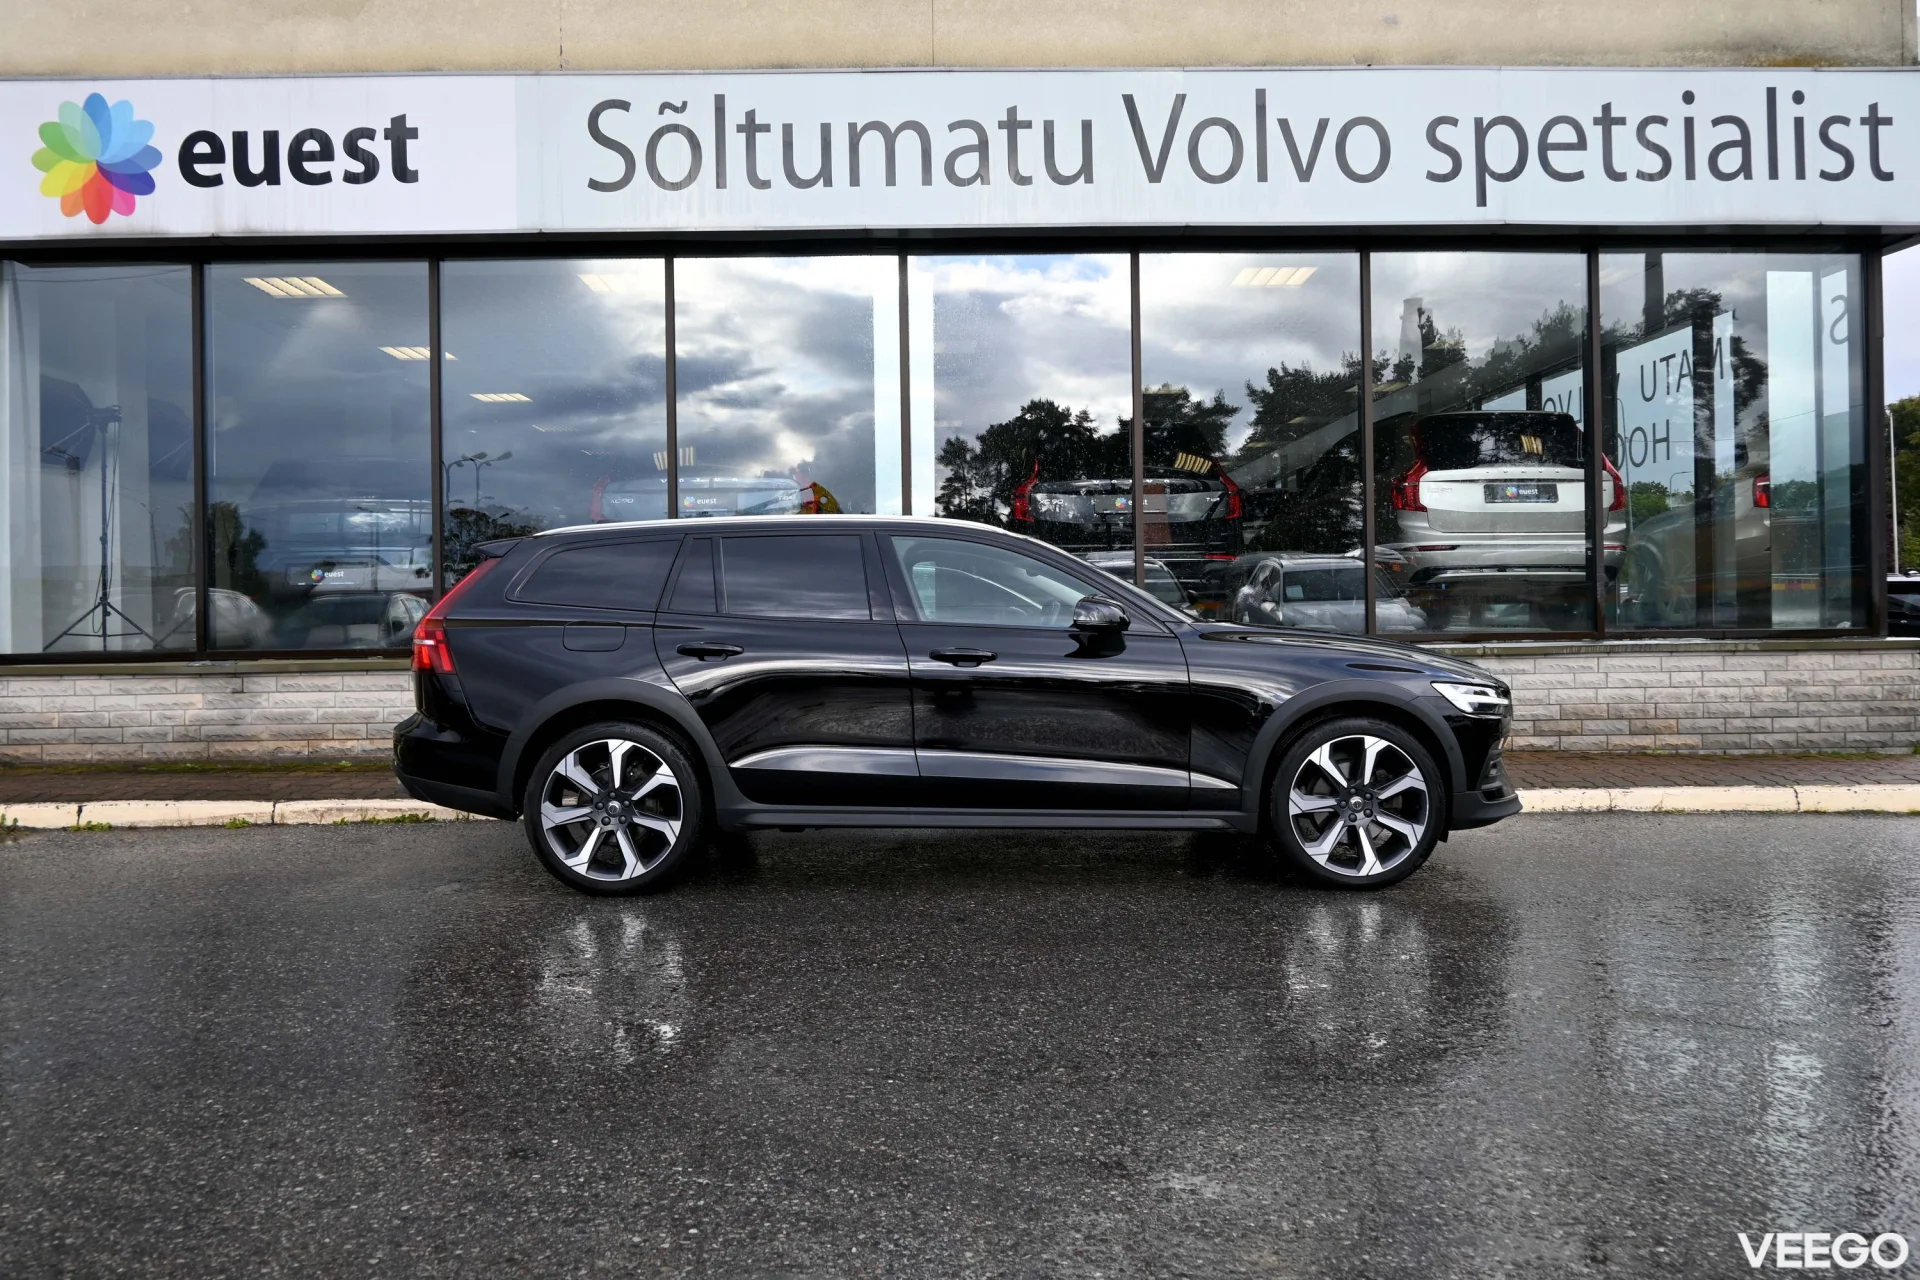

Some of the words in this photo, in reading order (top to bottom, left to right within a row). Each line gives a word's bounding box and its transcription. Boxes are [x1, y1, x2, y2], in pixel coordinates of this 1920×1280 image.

[178, 114, 418, 188] euest
[588, 94, 1093, 192] Sõltumatu
[1122, 89, 1390, 184] Volvo
[1426, 87, 1894, 207] spetsialist
[696, 497, 717, 505] euest
[324, 570, 345, 578] euest
